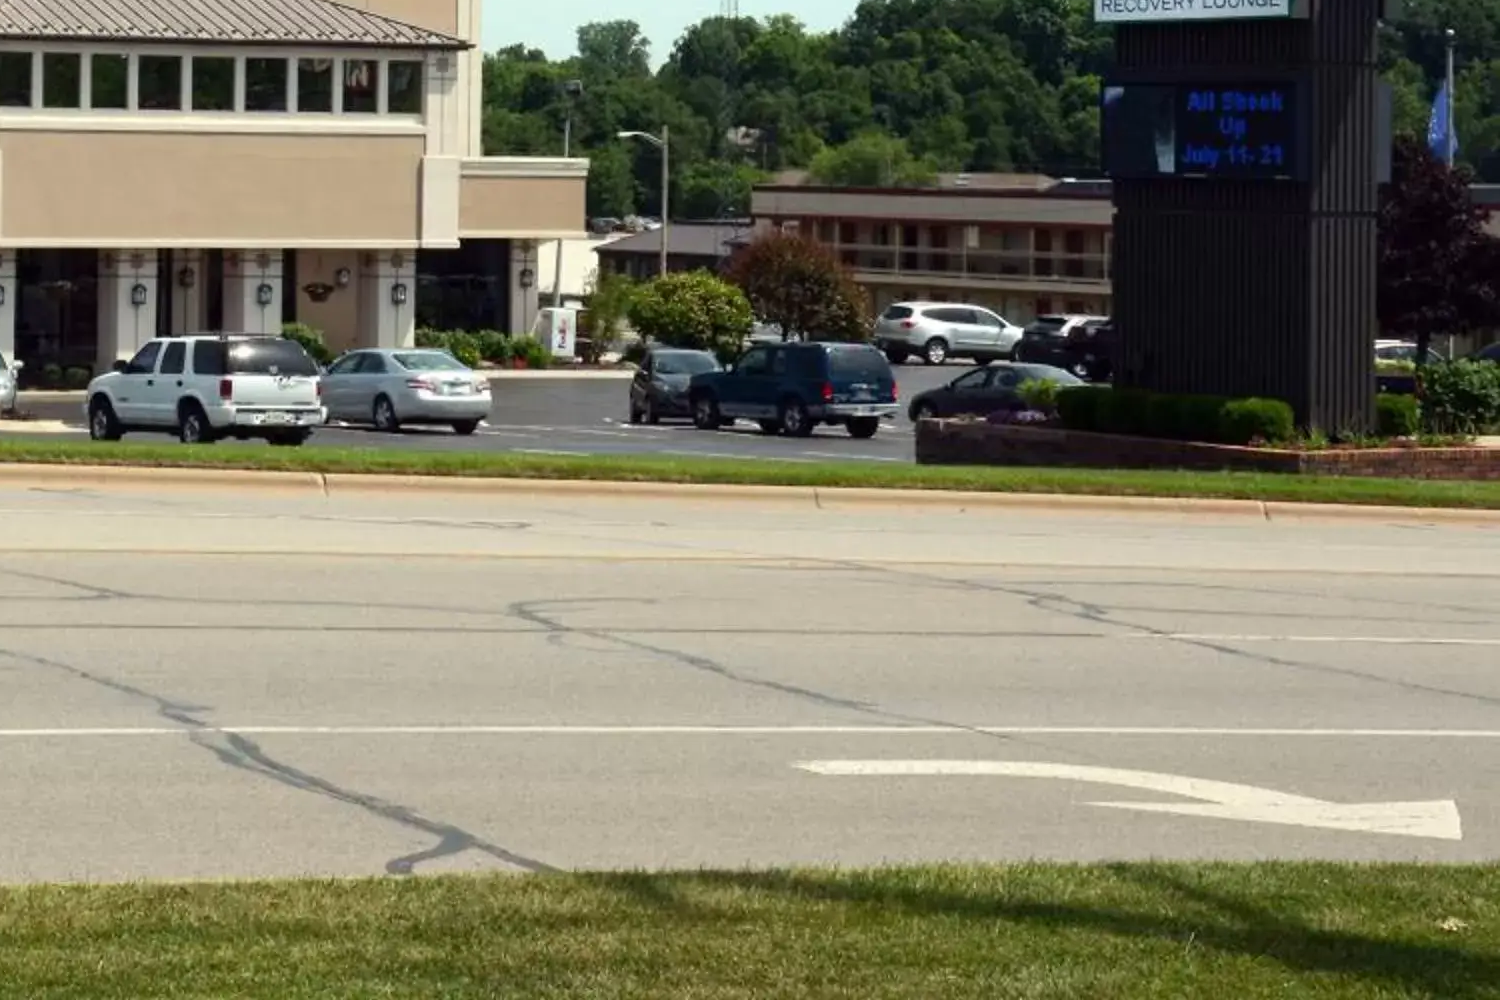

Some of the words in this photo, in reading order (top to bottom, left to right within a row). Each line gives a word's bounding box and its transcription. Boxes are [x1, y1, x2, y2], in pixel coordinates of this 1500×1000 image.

[1188, 90, 1215, 111] All
[1219, 116, 1246, 139] Up
[1182, 144, 1220, 169] July
